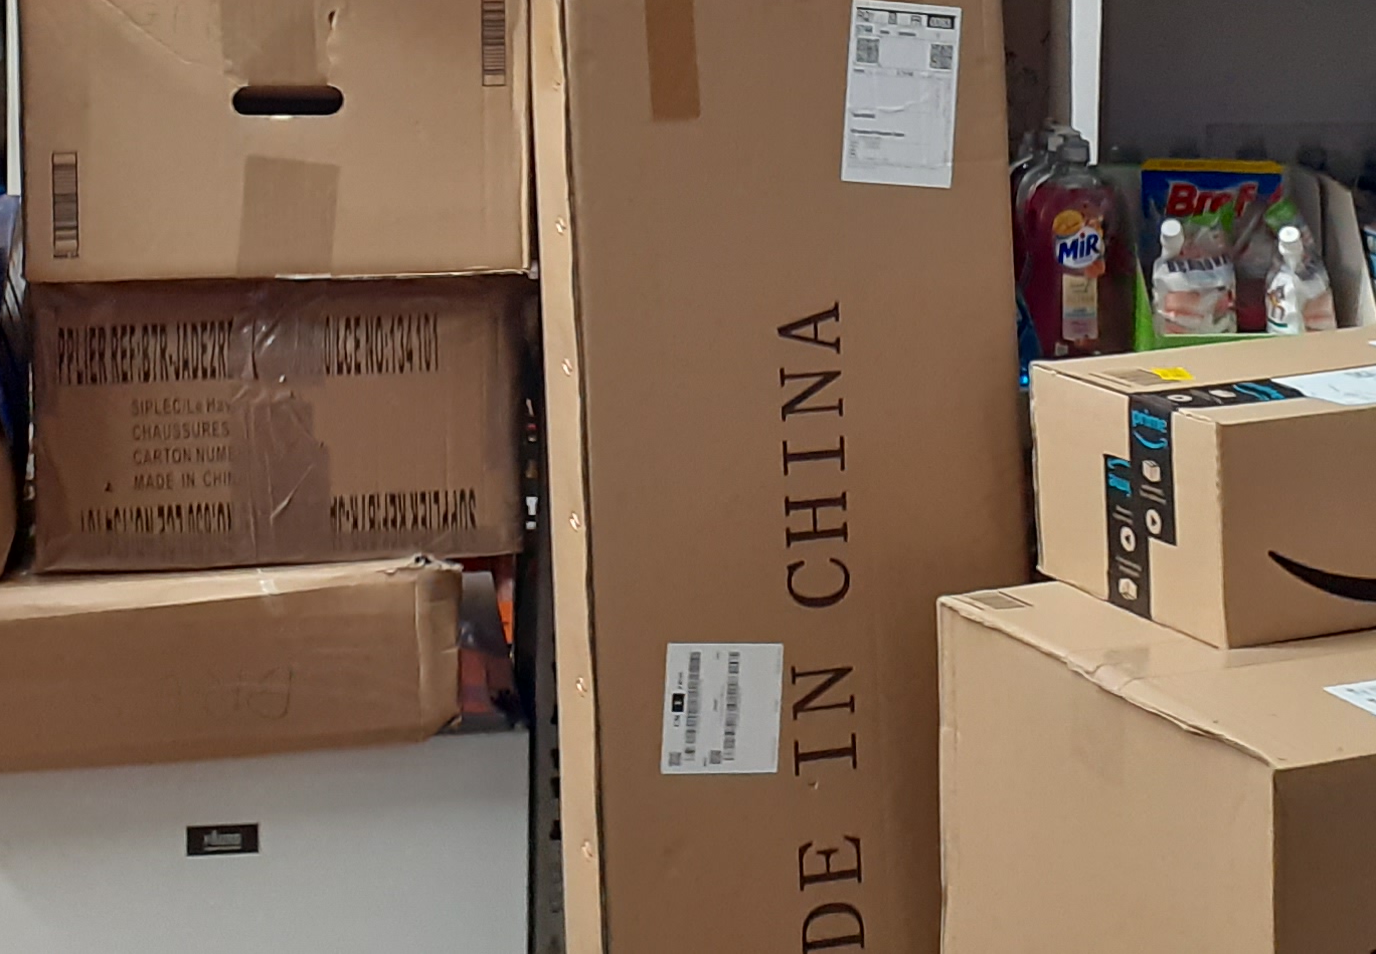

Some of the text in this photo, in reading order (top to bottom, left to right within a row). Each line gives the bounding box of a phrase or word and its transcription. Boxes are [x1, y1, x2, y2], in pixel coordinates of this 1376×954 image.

[1165, 182, 1258, 218] Bref
[133, 422, 230, 441] CHAUSSURES
[133, 473, 174, 490] MADE
[181, 472, 195, 488] IN
[776, 300, 866, 954] DE IN CHINA
